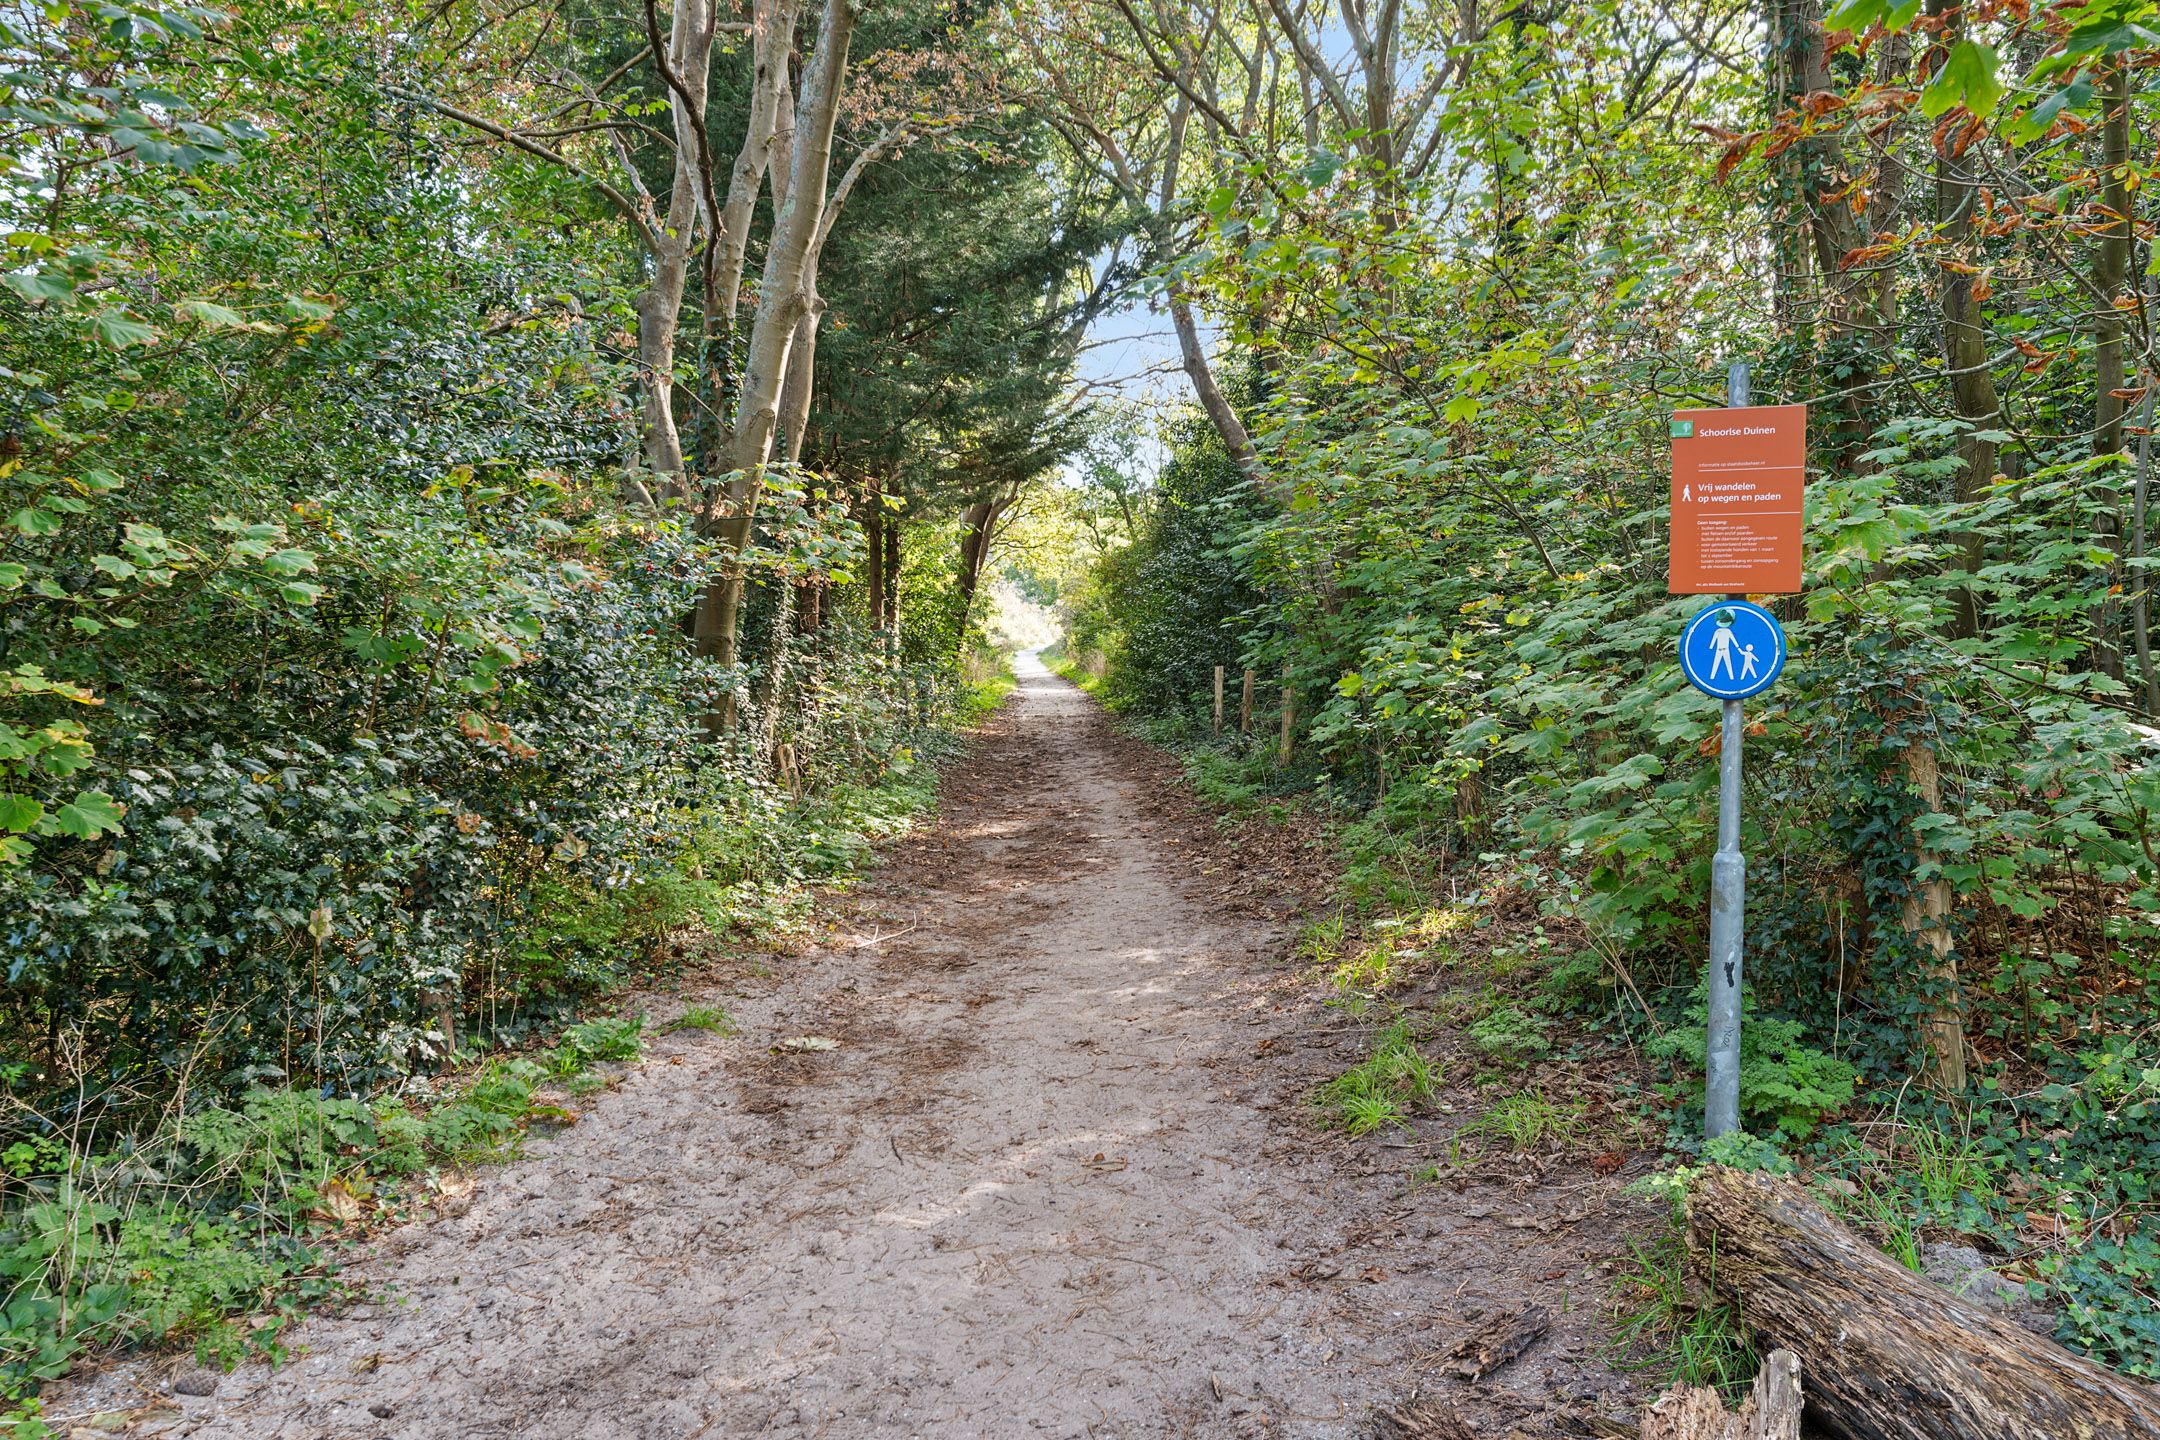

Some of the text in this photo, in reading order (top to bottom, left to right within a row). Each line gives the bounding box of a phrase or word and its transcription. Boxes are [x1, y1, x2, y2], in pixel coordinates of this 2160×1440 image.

[1700, 428, 1741, 437] Schoorlse
[1743, 427, 1775, 435] Duinen
[1698, 483, 1756, 493] Vrij wandelen
[1698, 492, 1781, 504] op wegen en paden
